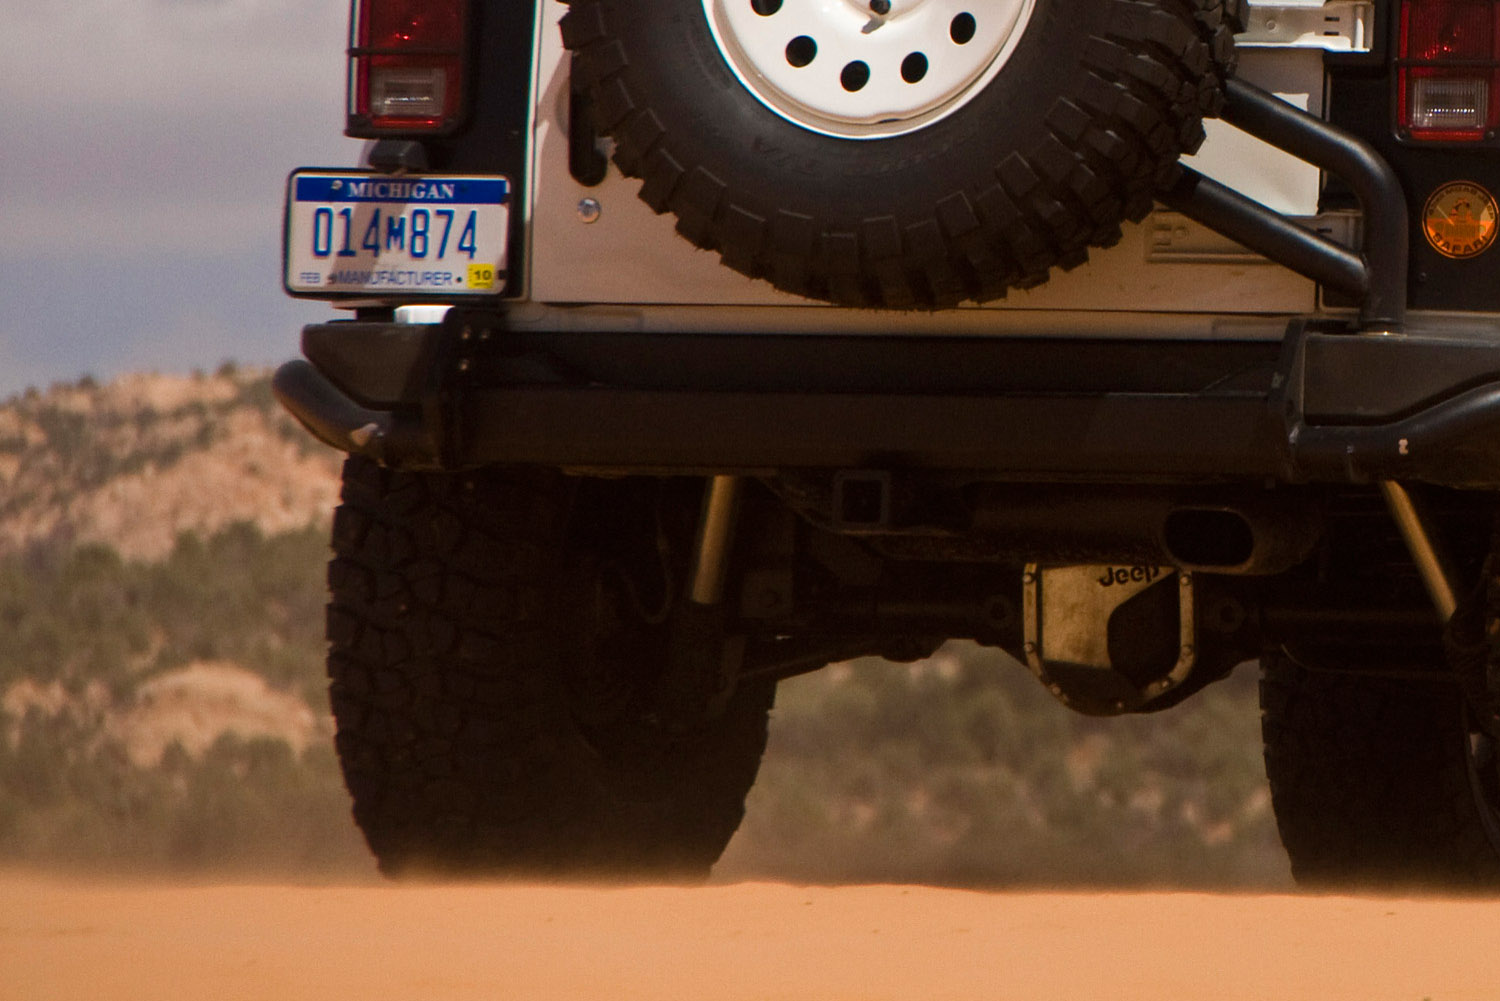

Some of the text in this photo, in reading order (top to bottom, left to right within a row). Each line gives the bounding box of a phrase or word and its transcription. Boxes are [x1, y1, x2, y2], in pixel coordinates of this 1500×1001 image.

[347, 182, 456, 199] MICHIGAN
[313, 206, 478, 261] 014M874
[1432, 231, 1488, 253] SAFARI
[336, 270, 453, 286] MANUFACTURER
[473, 269, 492, 281] 10
[1099, 565, 1160, 588] Jeep
